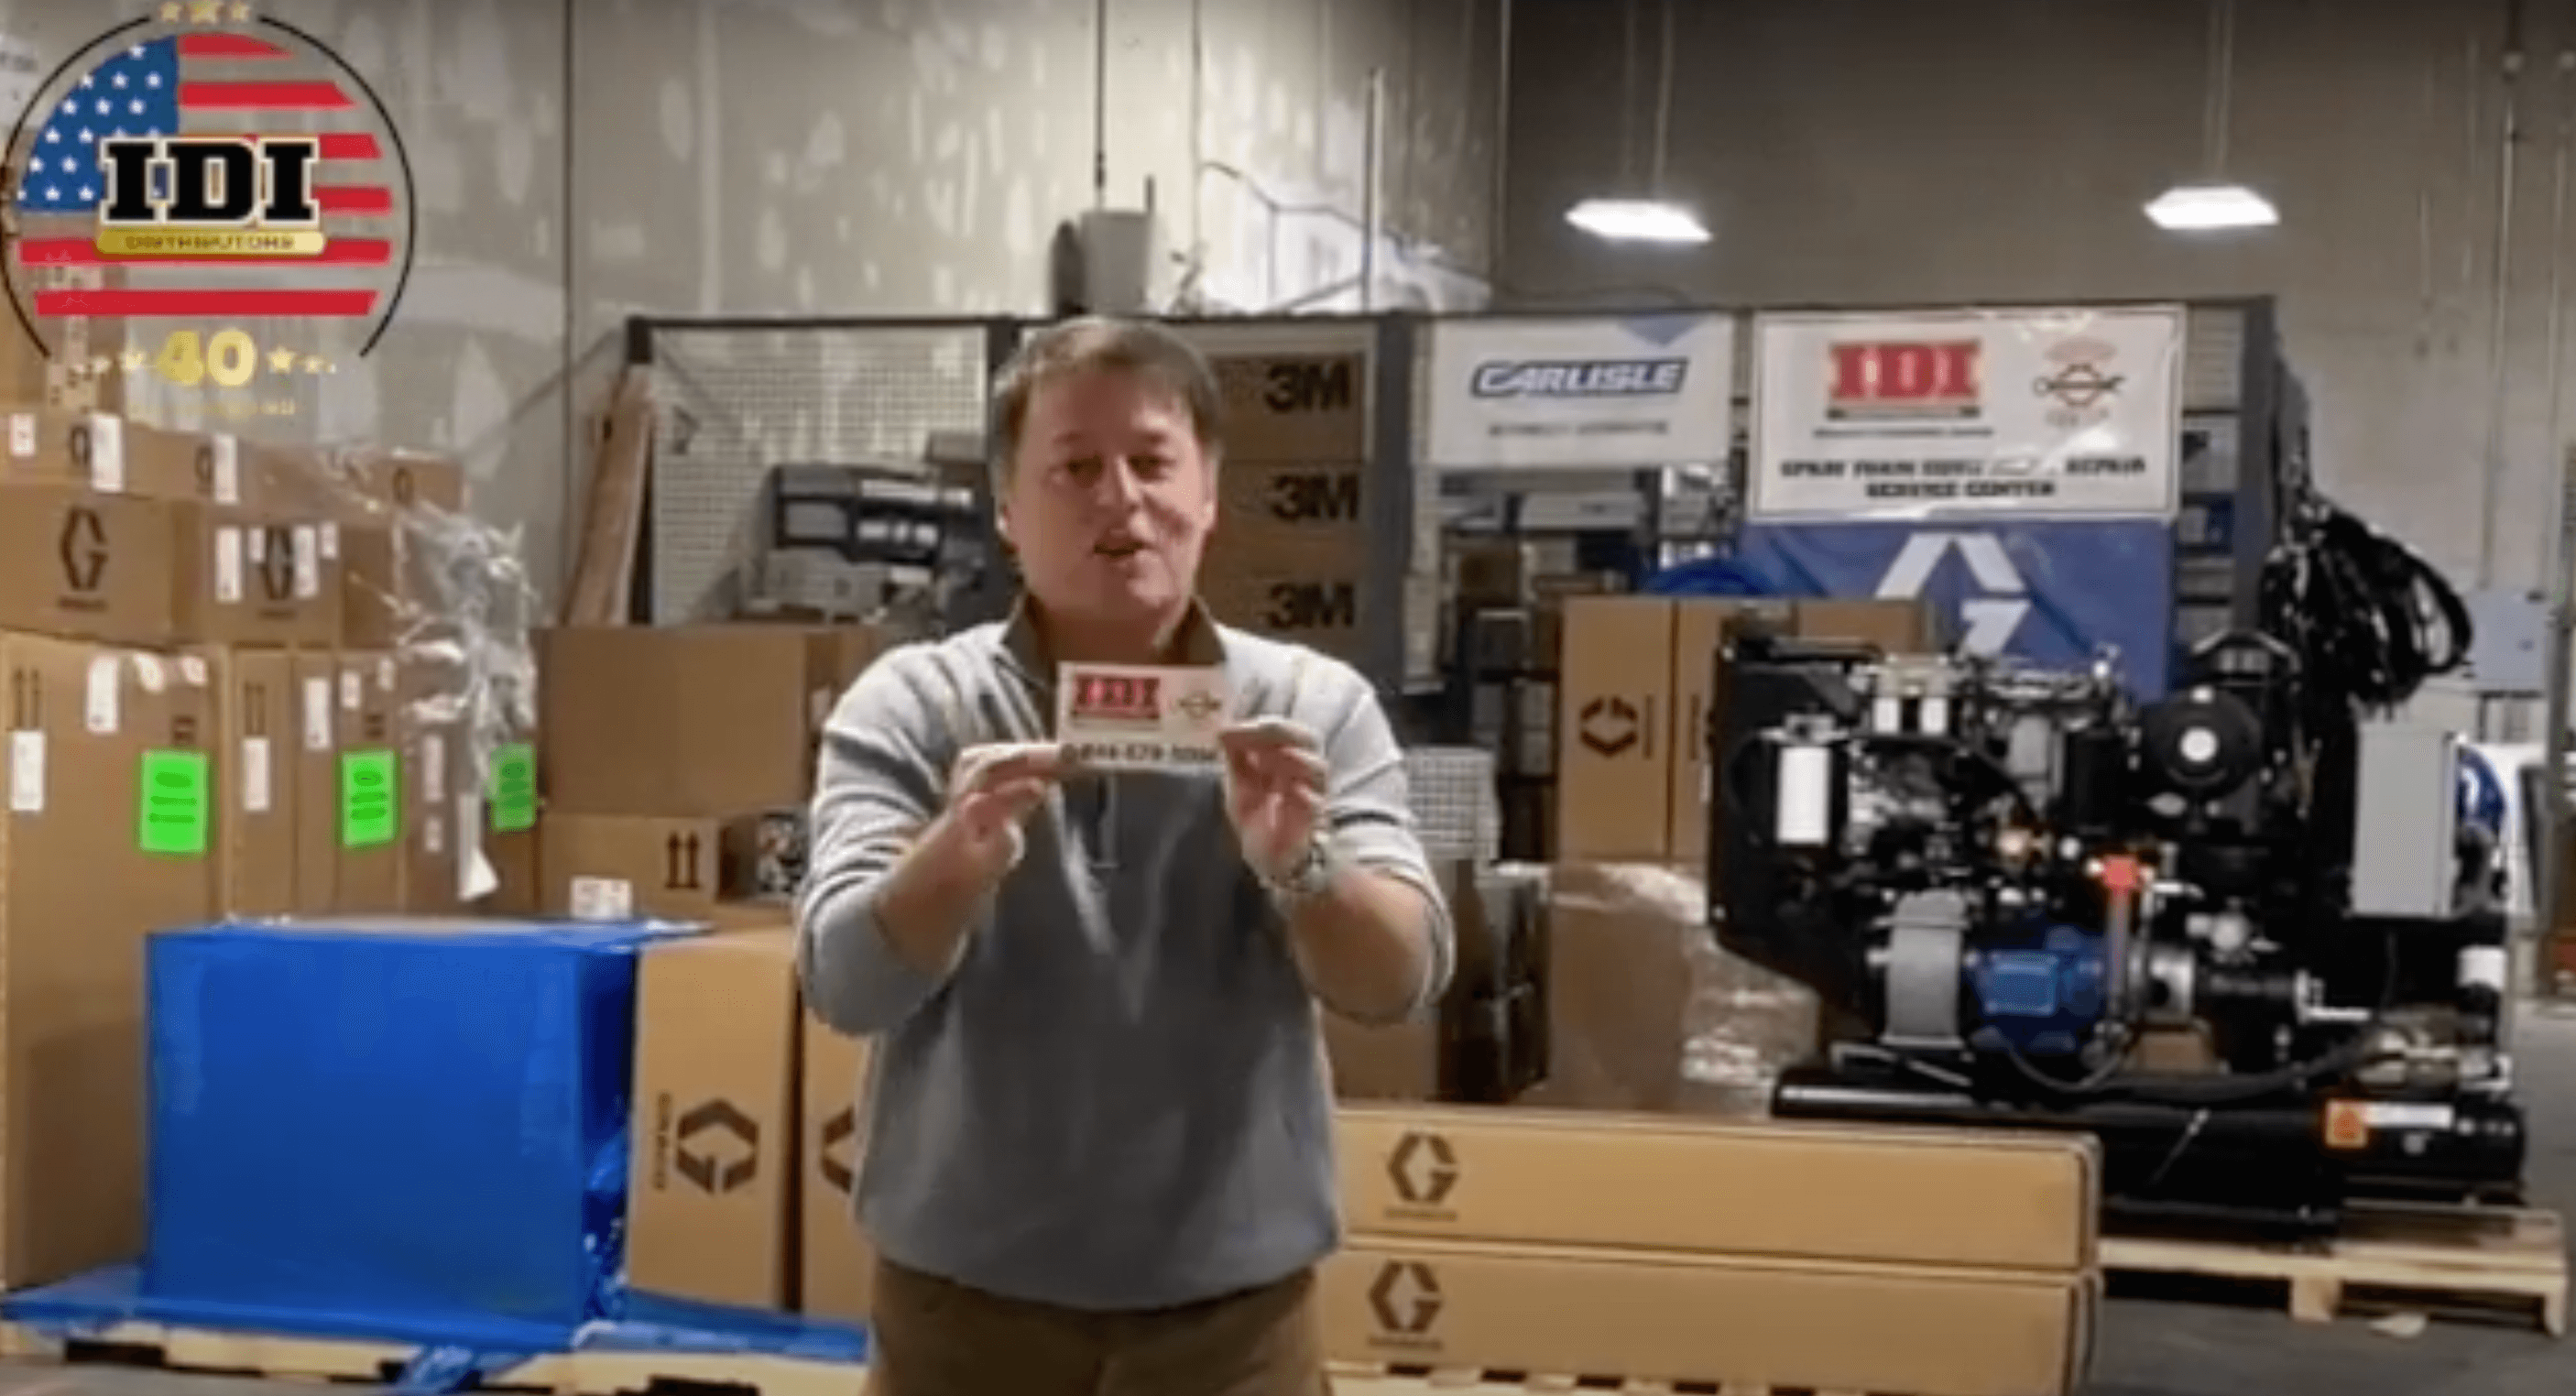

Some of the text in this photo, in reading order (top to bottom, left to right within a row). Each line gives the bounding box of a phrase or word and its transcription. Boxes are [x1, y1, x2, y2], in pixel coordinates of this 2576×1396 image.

[1266, 360, 1350, 411] 3M
[1473, 359, 1687, 396] CARLISLE
[1829, 341, 1981, 400] IDI
[1271, 473, 1359, 520] 3M
[1269, 580, 1356, 627] 3M
[1075, 674, 1161, 708] IDI
